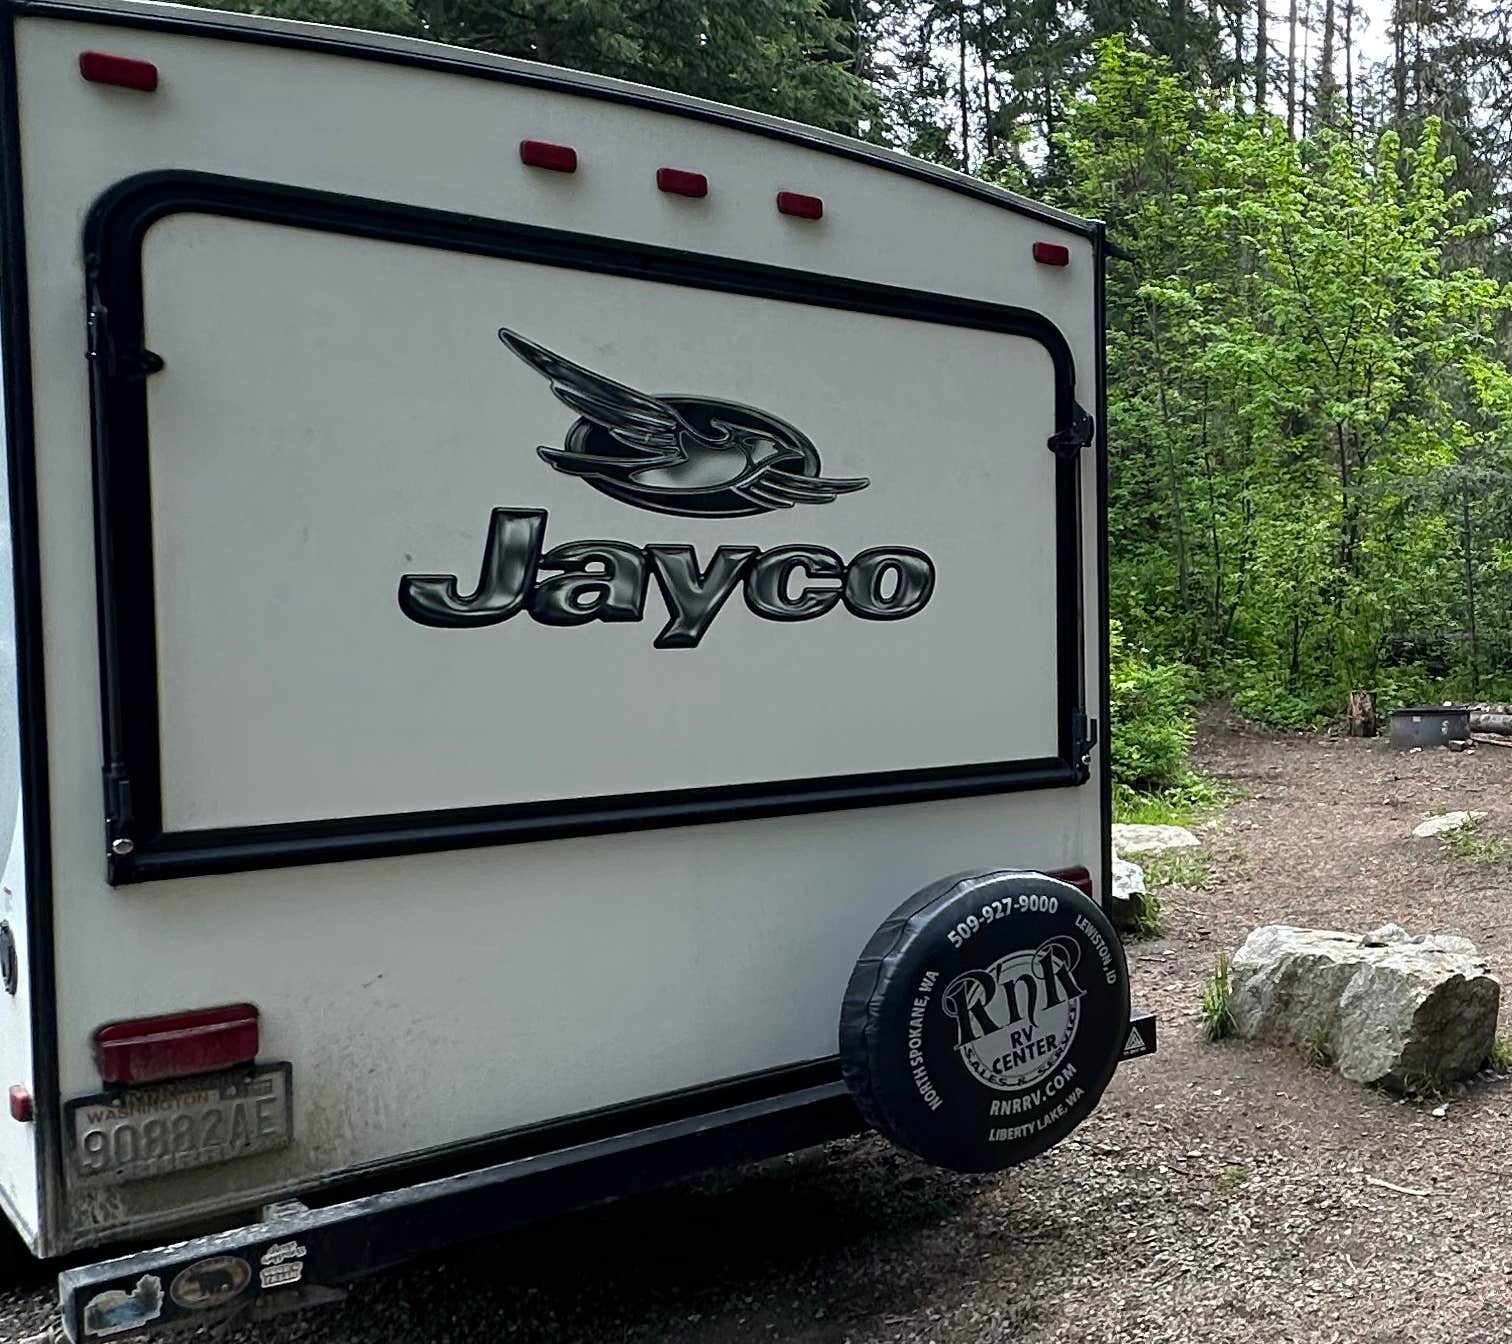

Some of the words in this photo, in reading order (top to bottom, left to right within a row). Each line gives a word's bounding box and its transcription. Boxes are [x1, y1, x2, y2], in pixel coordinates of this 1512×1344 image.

[398, 507, 936, 649] Jayco
[946, 893, 1059, 949] 509-927-9000
[918, 970, 940, 993] WA
[991, 1033, 1058, 1075] CENTER
[1010, 1025, 1034, 1050] RV
[913, 1065, 943, 1111] NORTH
[988, 1062, 1078, 1117] RNRRV.COM
[988, 1122, 1035, 1142] LIBERTY
[1064, 1086, 1086, 1109] WA
